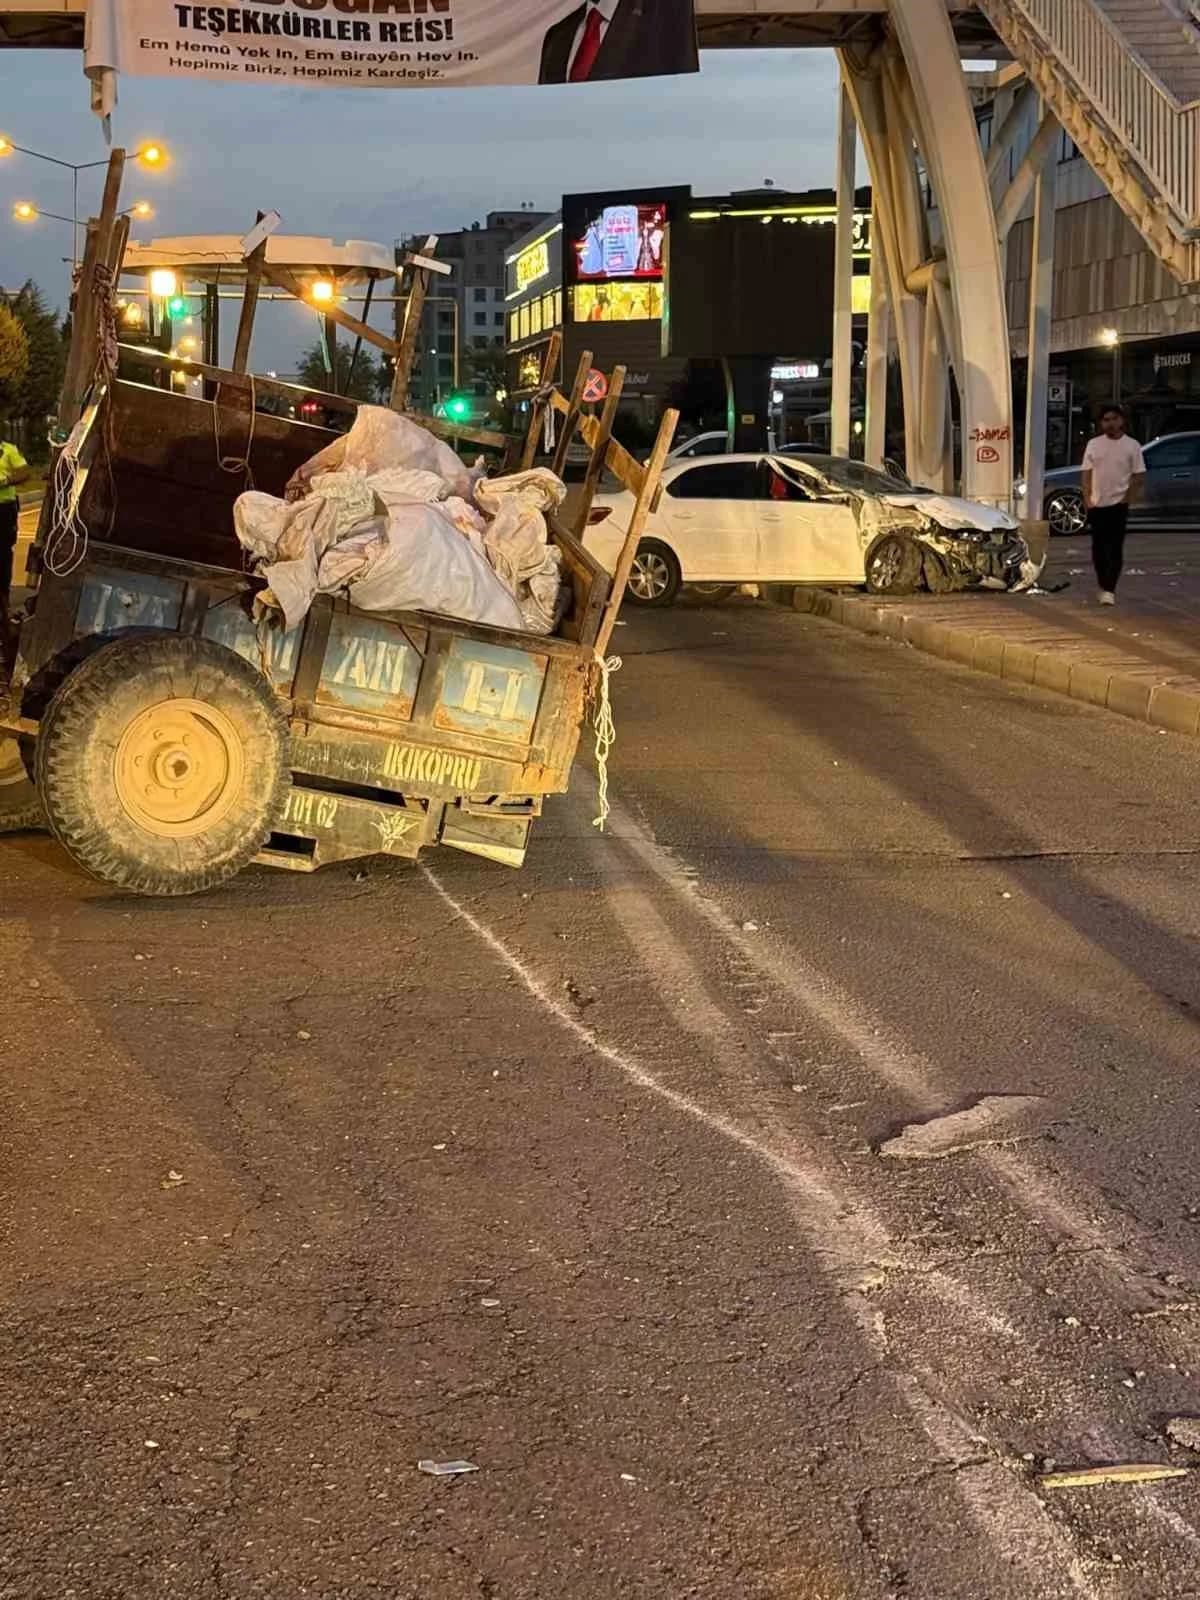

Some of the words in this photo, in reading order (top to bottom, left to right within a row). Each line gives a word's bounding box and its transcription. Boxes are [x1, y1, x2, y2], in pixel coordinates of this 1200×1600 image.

[174, 4, 371, 42] TEŞEKKÜRLER
[379, 18, 453, 42] REİS!
[140, 38, 169, 50] Em
[237, 46, 271, 58] Yek
[277, 47, 299, 61] In,
[305, 49, 334, 60] Em
[341, 50, 411, 64] Birayên
[417, 51, 452, 62] Hev
[458, 51, 479, 61] In.
[169, 57, 241, 71] Hepimiz
[245, 64, 287, 76] Biriz,
[294, 66, 361, 78] Hepimiz
[367, 68, 445, 80] Kardeşiz.
